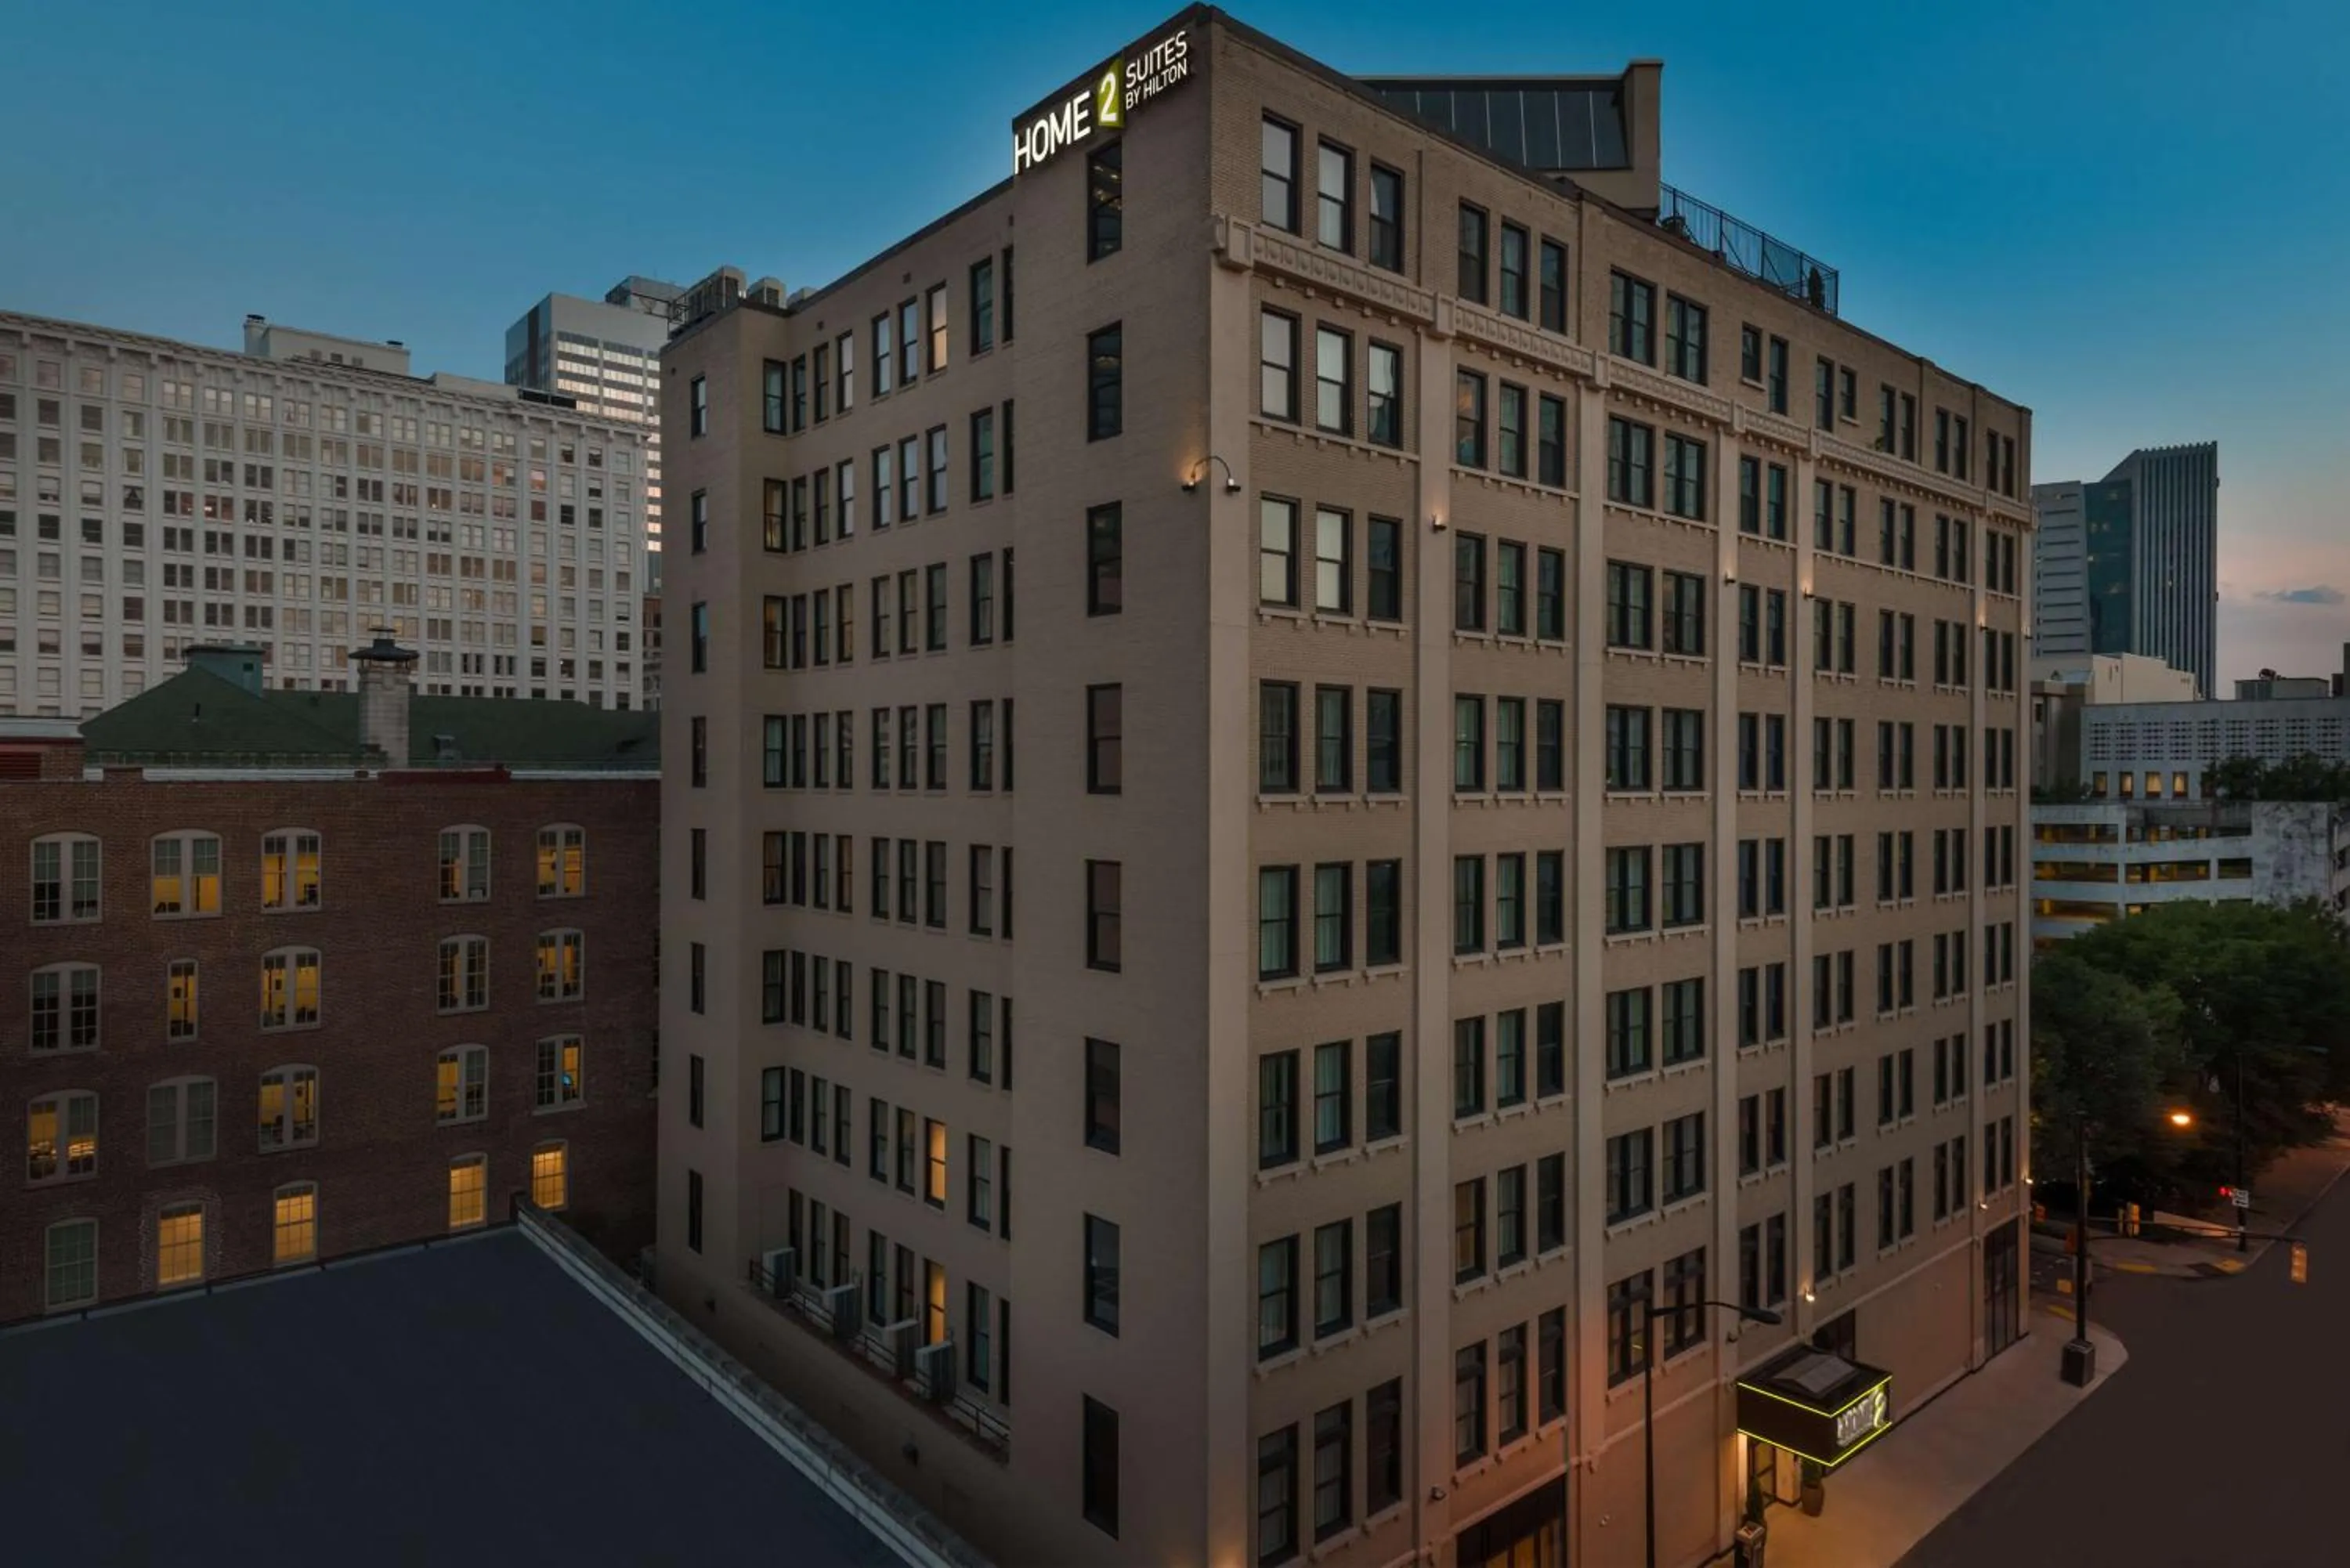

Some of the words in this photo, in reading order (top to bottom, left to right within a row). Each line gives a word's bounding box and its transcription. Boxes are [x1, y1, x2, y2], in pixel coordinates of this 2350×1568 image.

[1125, 31, 1188, 89] SUITES
[1125, 89, 1143, 110] BY
[1143, 58, 1188, 100] HILTON
[1014, 90, 1091, 175] HOME
[1100, 72, 1118, 123] 2
